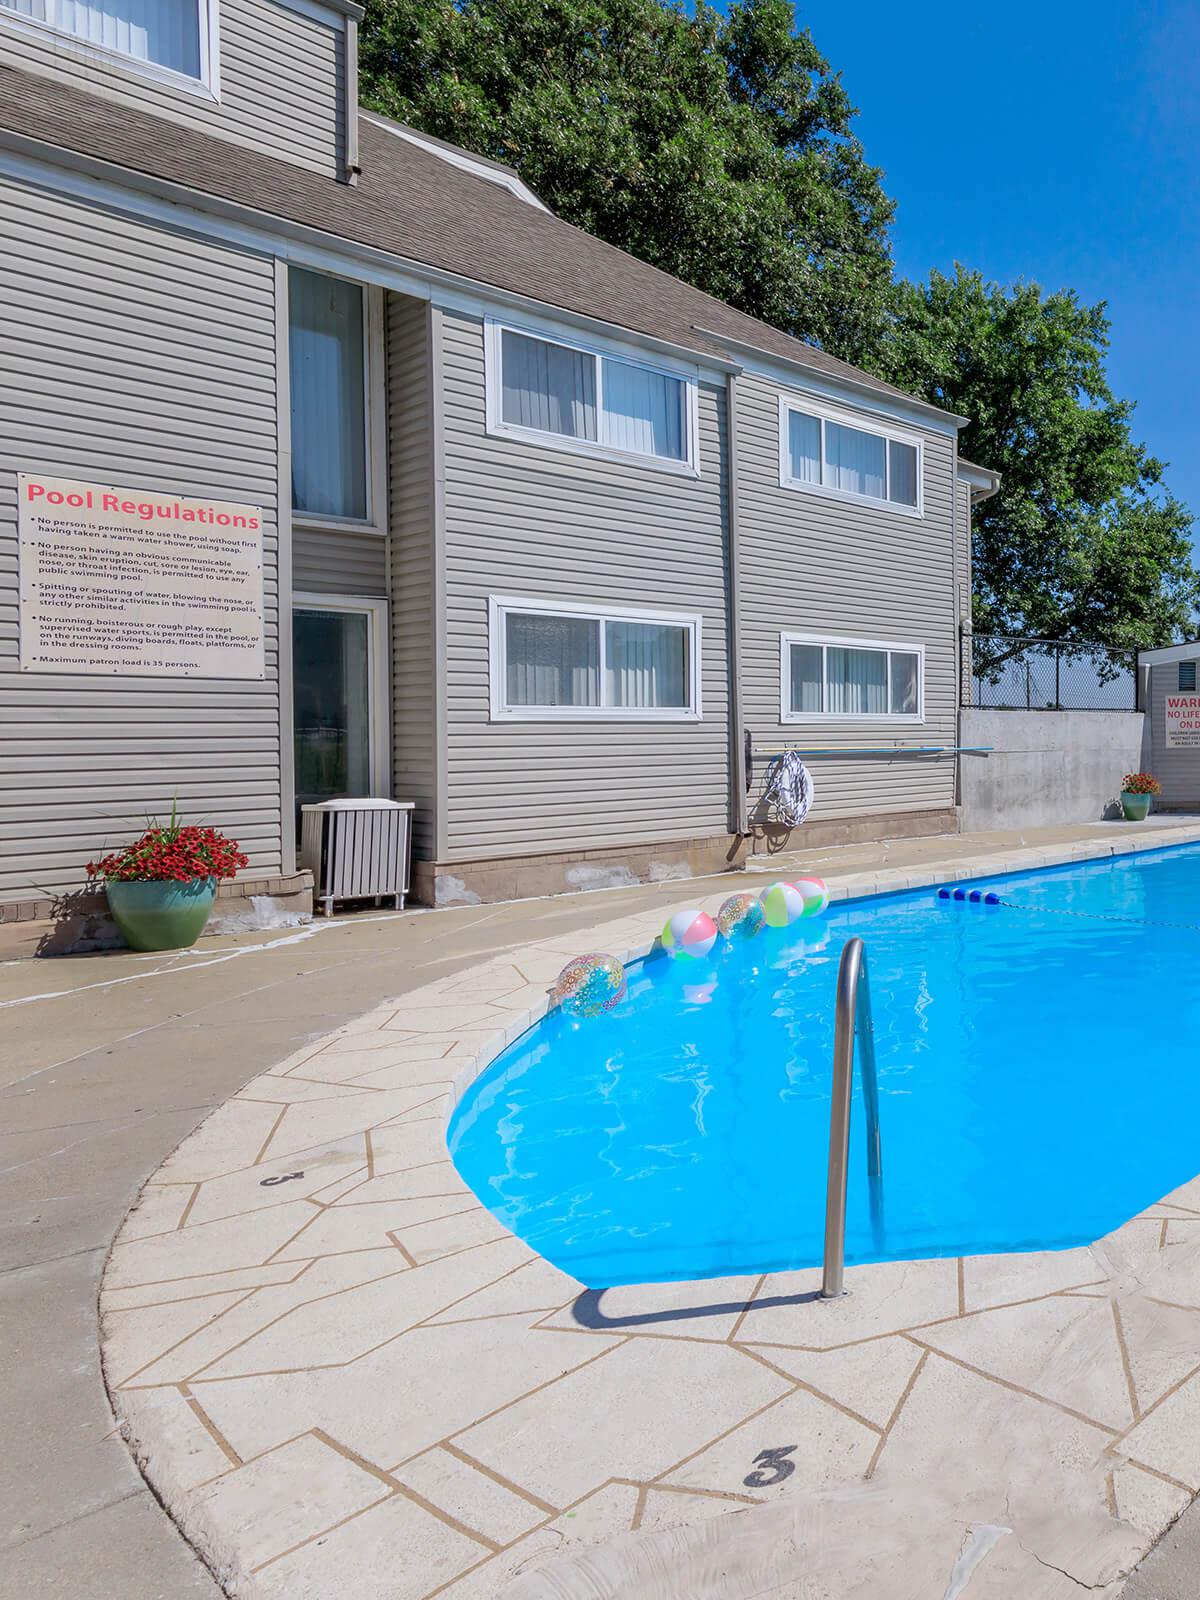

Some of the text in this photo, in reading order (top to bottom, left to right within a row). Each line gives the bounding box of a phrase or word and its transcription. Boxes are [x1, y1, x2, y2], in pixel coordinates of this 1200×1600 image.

[28, 484, 259, 529] Pool Regulations
[38, 525, 71, 536] having
[74, 530, 100, 538] taken
[197, 544, 219, 552] using
[53, 520, 87, 529] person
[98, 525, 143, 535] permitted
[209, 538, 241, 546] without
[89, 547, 120, 556] having
[135, 552, 170, 561] obvious
[172, 556, 232, 567] communicable
[38, 567, 68, 575] public
[70, 570, 118, 580] swimming
[78, 562, 107, 570] throat
[162, 570, 204, 579] permitted
[38, 583, 77, 593] Spitting
[91, 588, 132, 597] spouting
[173, 593, 207, 603] blowing
[39, 600, 72, 609] strictly
[86, 594, 117, 603] similar
[119, 598, 160, 606] activities
[188, 603, 229, 612] swimming
[39, 624, 91, 633] supervised
[162, 631, 204, 639] permitted
[96, 618, 144, 627] boisterous
[157, 623, 183, 631] rough
[69, 641, 109, 650] dressing
[115, 636, 144, 644] diving
[39, 656, 87, 664] Maximum
[1168, 710, 1180, 718] NO
[743, 1445, 798, 1487] 3
